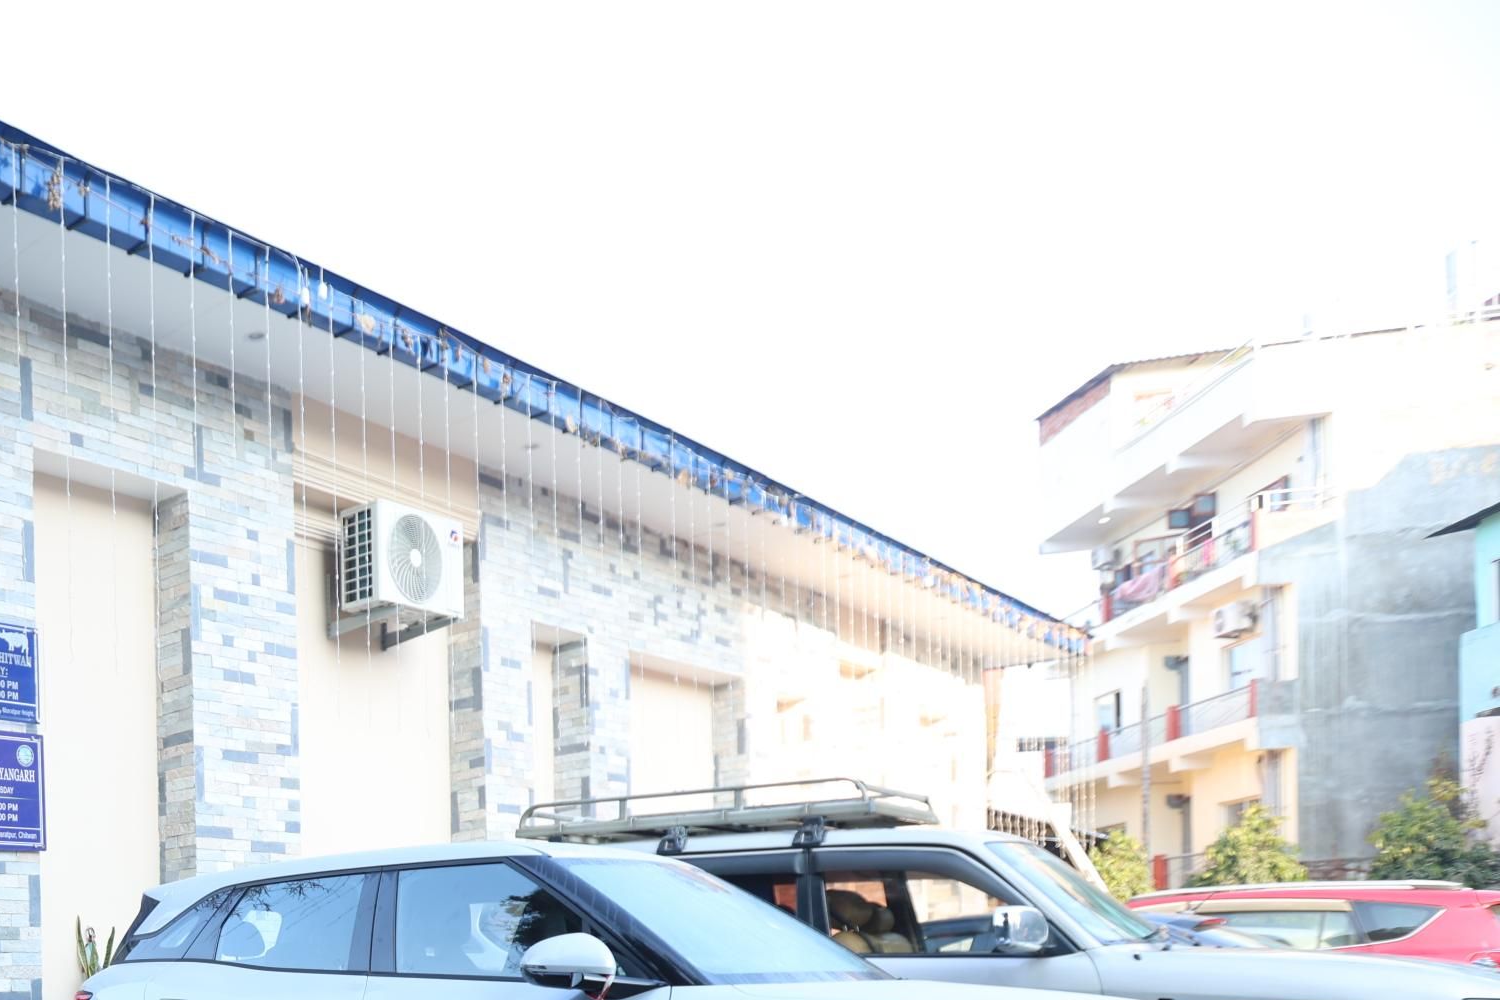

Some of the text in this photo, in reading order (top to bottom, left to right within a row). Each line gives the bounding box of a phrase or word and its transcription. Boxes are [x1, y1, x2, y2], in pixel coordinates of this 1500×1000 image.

[6, 680, 19, 690] PM
[7, 690, 19, 701] PM
[7, 803, 19, 811] PM
[7, 813, 19, 822] PM
